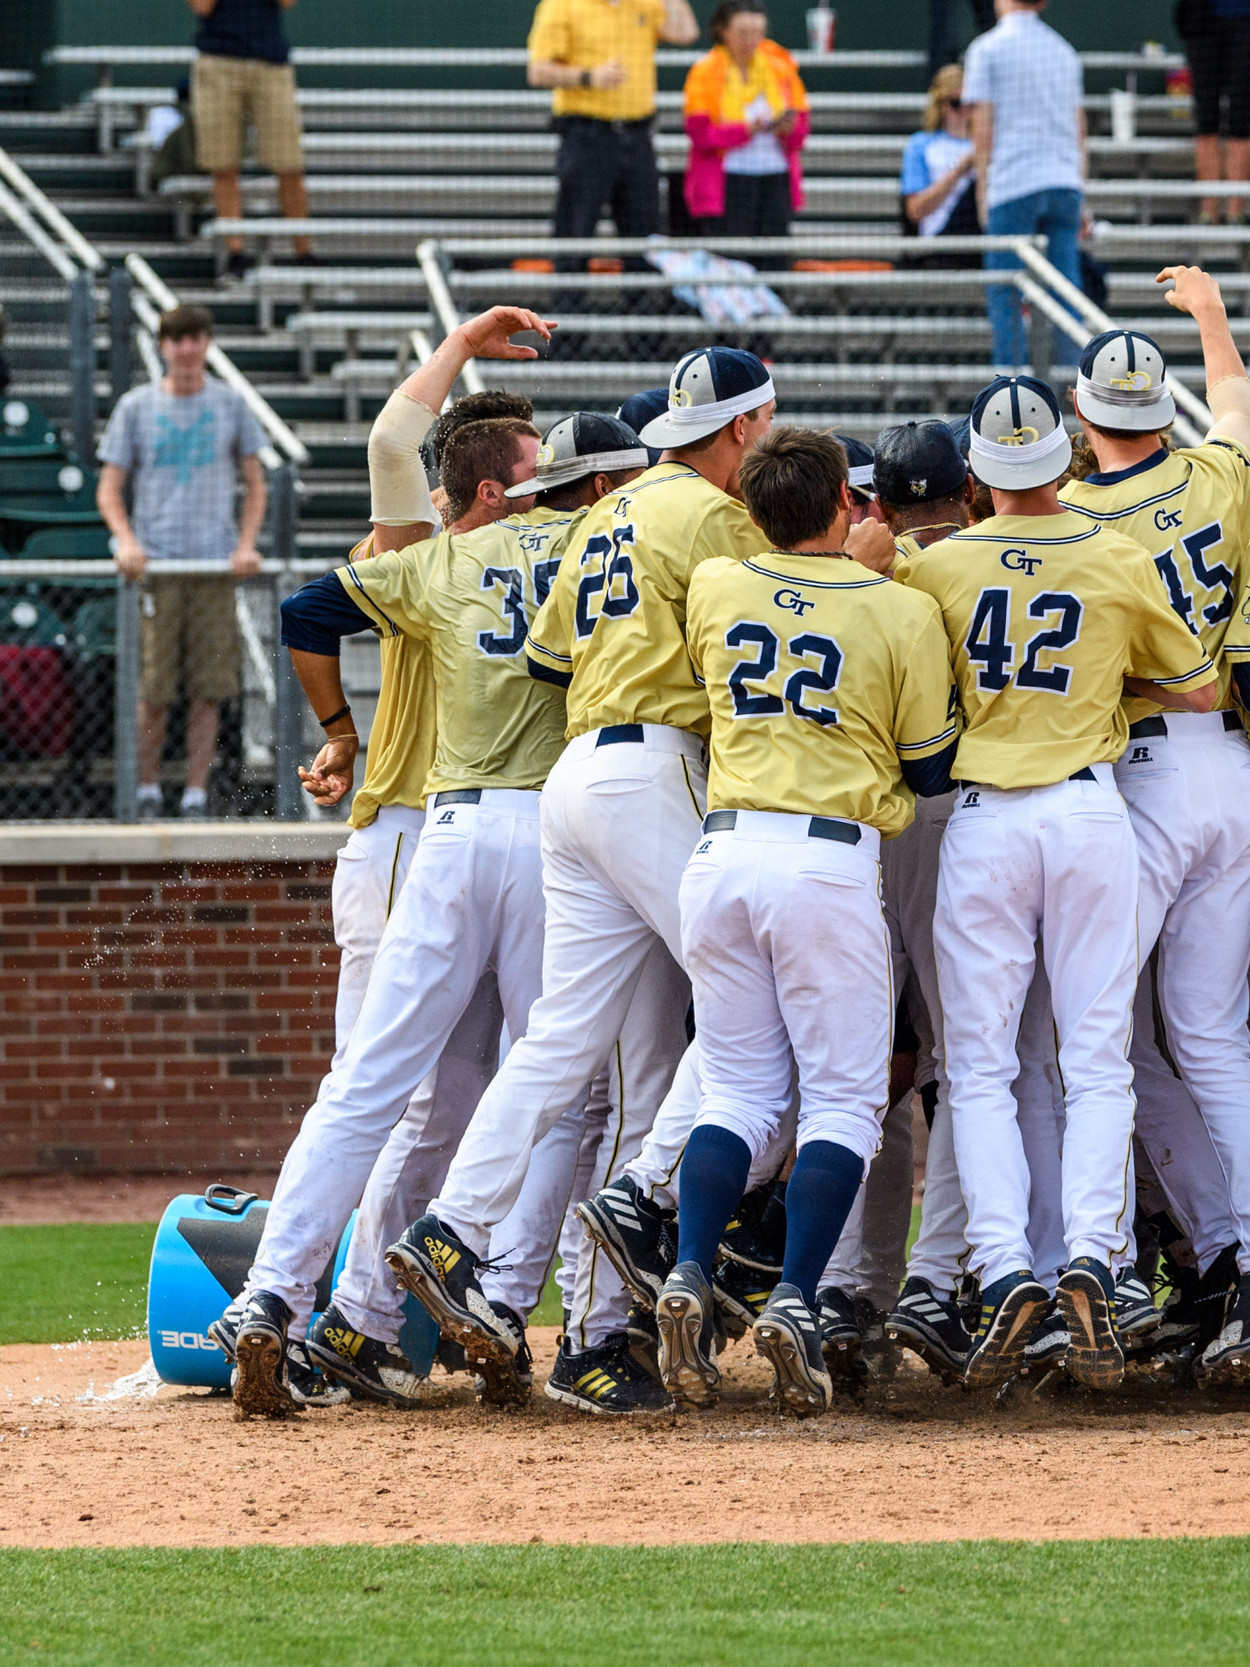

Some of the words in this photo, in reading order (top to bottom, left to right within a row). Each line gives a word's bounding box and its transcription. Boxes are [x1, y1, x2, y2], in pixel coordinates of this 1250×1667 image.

[1154, 508, 1183, 531] GT
[1000, 548, 1043, 576] GT
[575, 524, 640, 642] 26
[773, 588, 815, 616] GT
[963, 586, 1086, 696] 42
[724, 619, 845, 728] 22
[161, 1330, 220, 1351] ADE
[324, 1327, 356, 1365] adida
